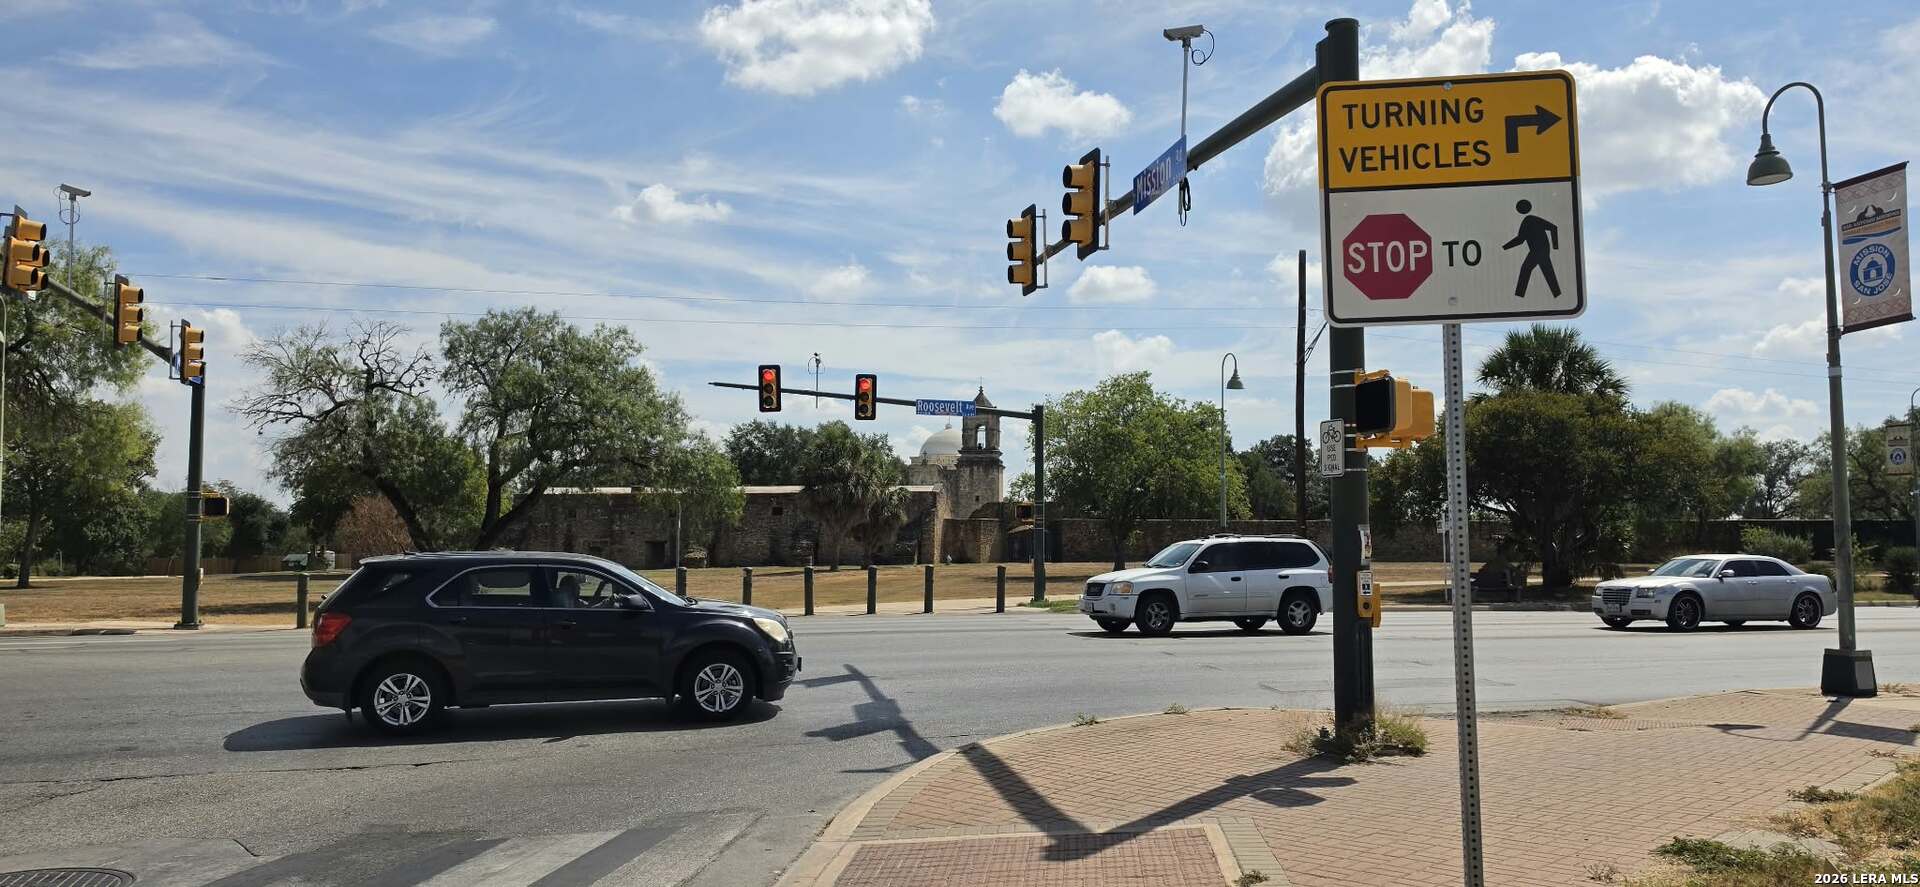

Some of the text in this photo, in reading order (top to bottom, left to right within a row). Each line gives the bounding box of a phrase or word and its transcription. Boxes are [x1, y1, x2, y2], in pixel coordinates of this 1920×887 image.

[1342, 97, 1485, 129] TURNING
[1338, 140, 1491, 173] VEHICLES
[1136, 157, 1171, 203] Mission
[1347, 240, 1482, 274] STOP TO
[1853, 245, 1890, 266] MISSION
[1853, 279, 1871, 294] SAN
[917, 400, 962, 412] Roosevelt
